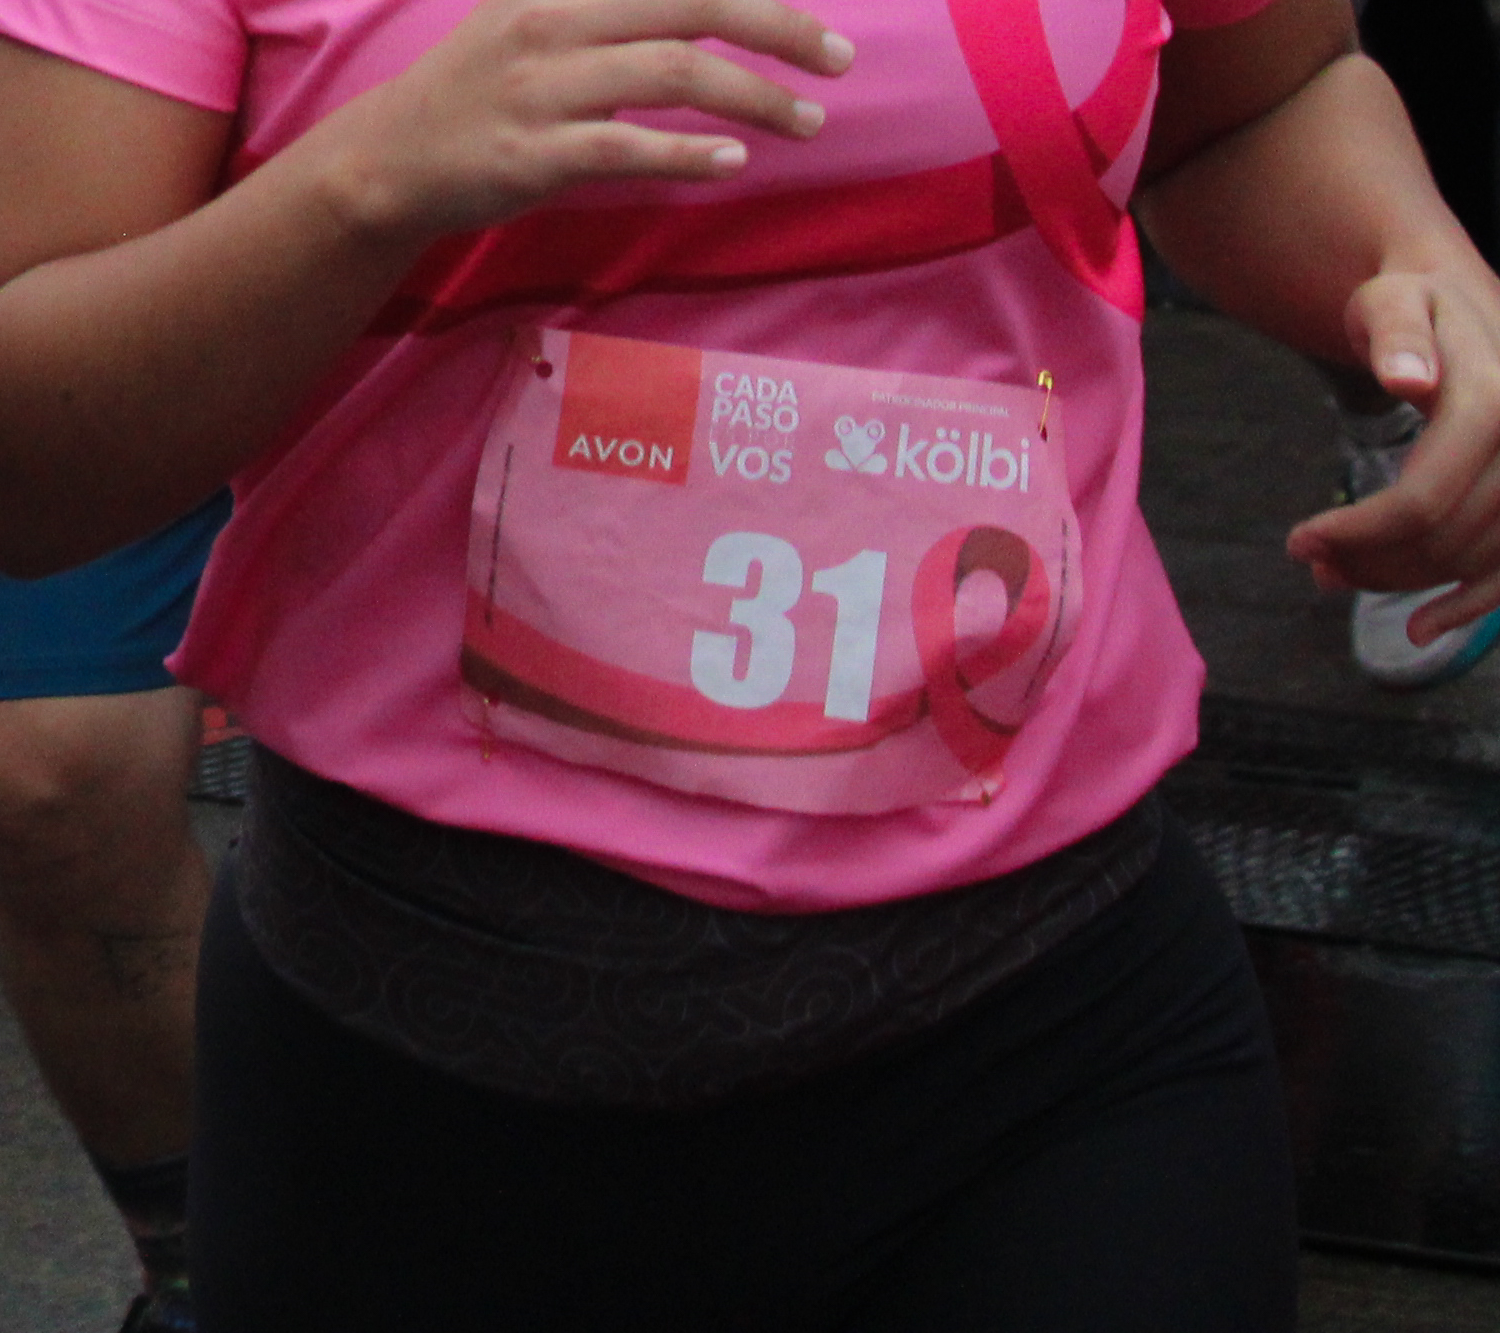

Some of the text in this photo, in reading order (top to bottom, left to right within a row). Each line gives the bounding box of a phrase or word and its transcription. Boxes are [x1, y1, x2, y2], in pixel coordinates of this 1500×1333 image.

[714, 372, 798, 405] CADA
[711, 395, 800, 433] PASO
[568, 433, 675, 471] AVON
[709, 441, 794, 485] VOS
[894, 421, 1031, 493] kölbi
[690, 529, 888, 724] 31
